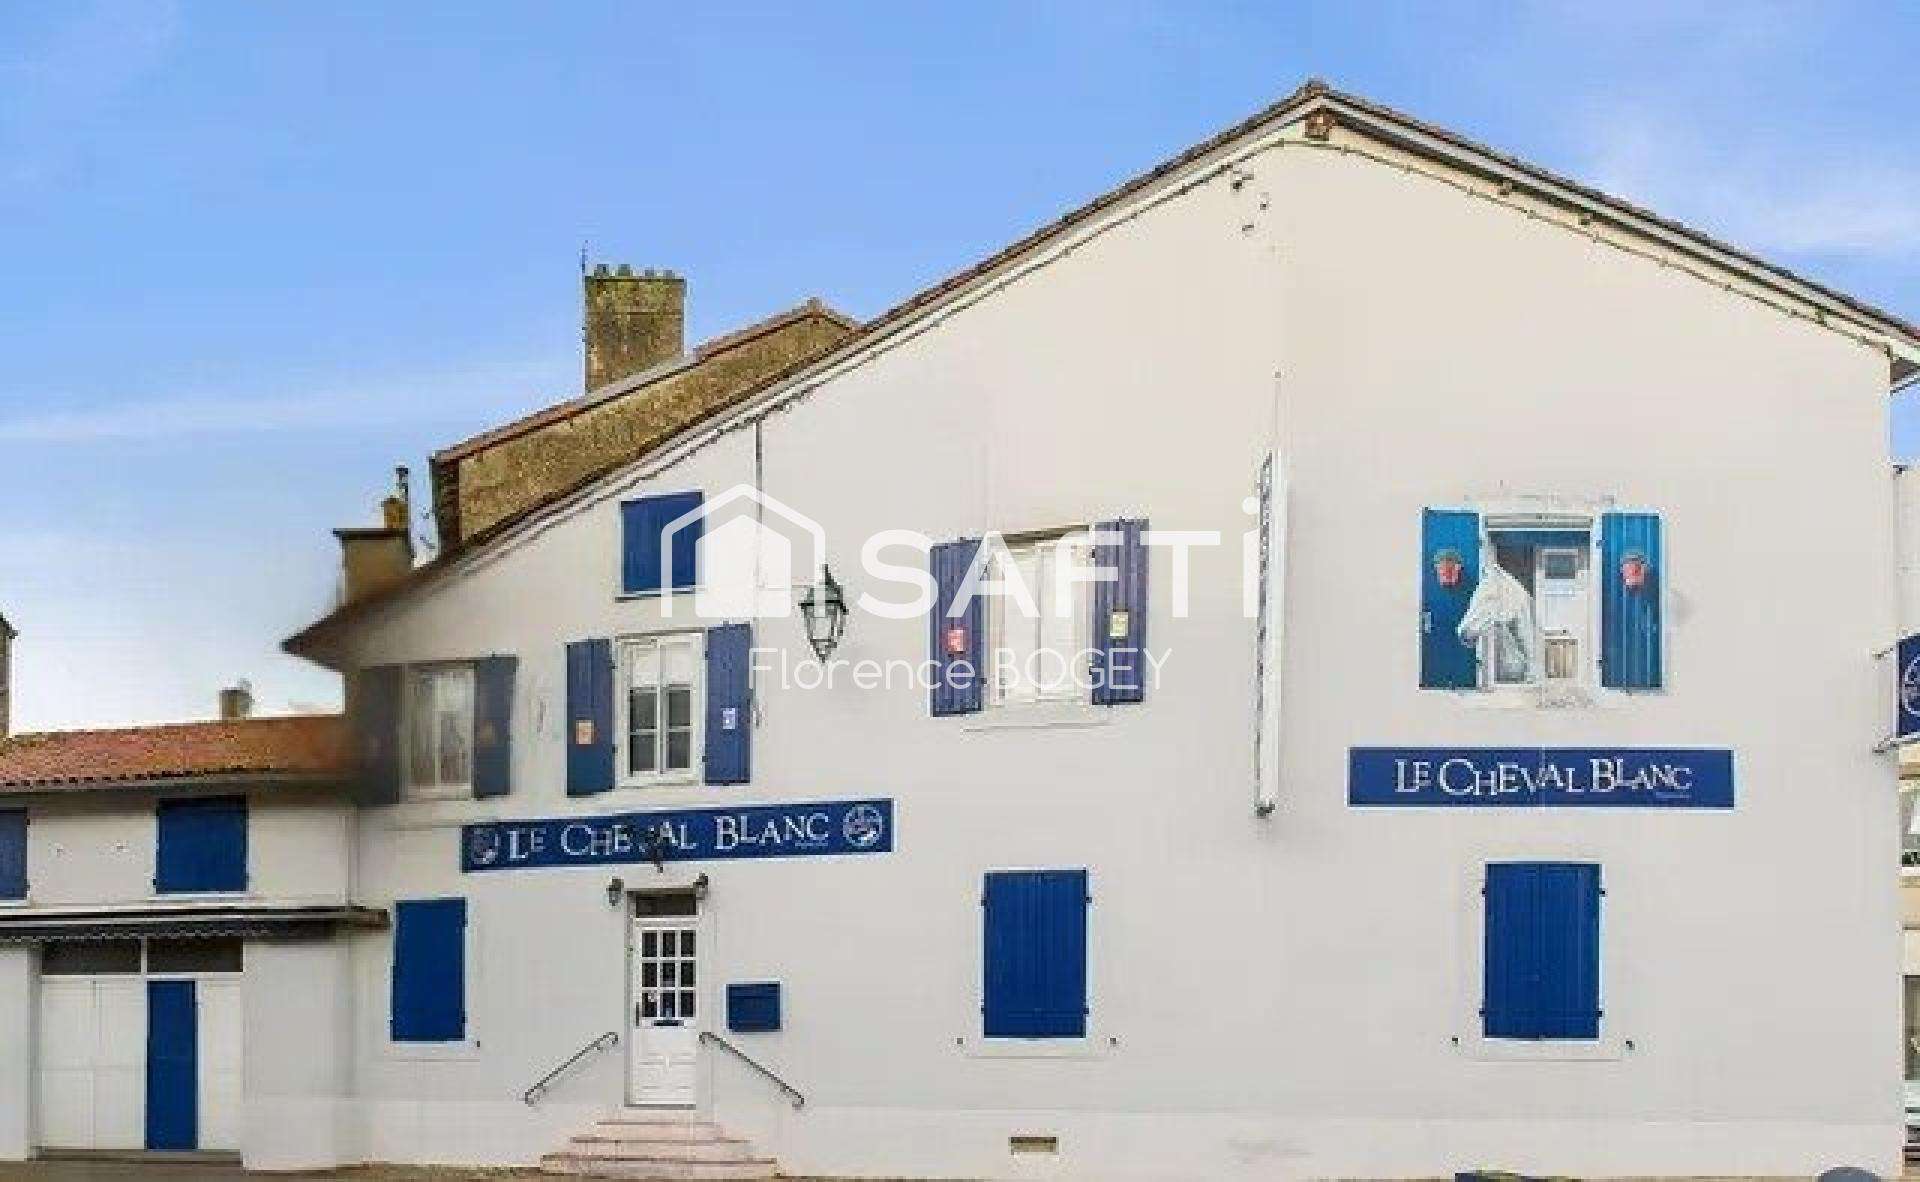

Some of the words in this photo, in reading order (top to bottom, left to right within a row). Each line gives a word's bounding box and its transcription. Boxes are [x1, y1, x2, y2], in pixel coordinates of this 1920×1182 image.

[1395, 758, 1431, 793] LE
[1438, 757, 1585, 796] CHEVAL
[1589, 756, 1693, 793] BLANC
[508, 826, 548, 862] LE
[713, 811, 829, 850] BLANC
